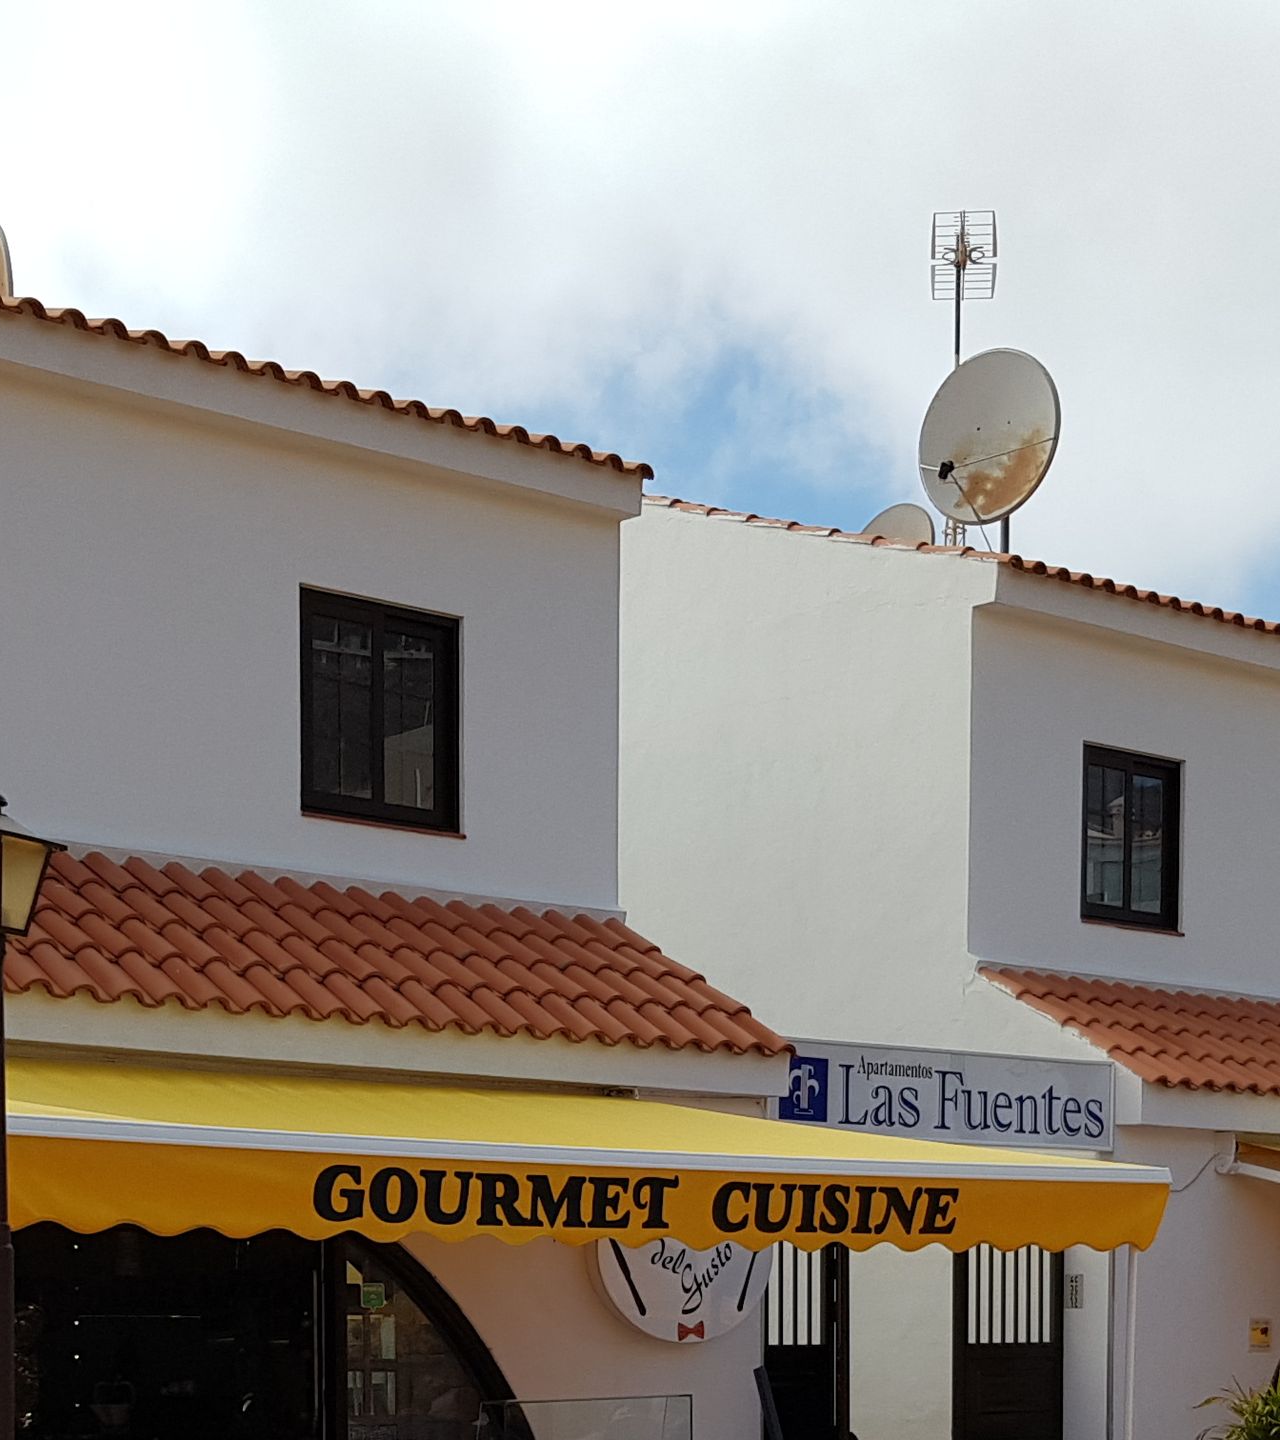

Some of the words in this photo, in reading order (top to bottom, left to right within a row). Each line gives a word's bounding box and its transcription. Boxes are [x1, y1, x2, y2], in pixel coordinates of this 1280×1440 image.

[837, 1063, 921, 1128] Las
[933, 1070, 1106, 1138] Fuentes
[857, 1055, 933, 1080] Apartamentos
[313, 1164, 680, 1230] GOURMET
[711, 1180, 960, 1235] CUISINE
[651, 1238, 687, 1274] del
[681, 1242, 733, 1315] Gusto
